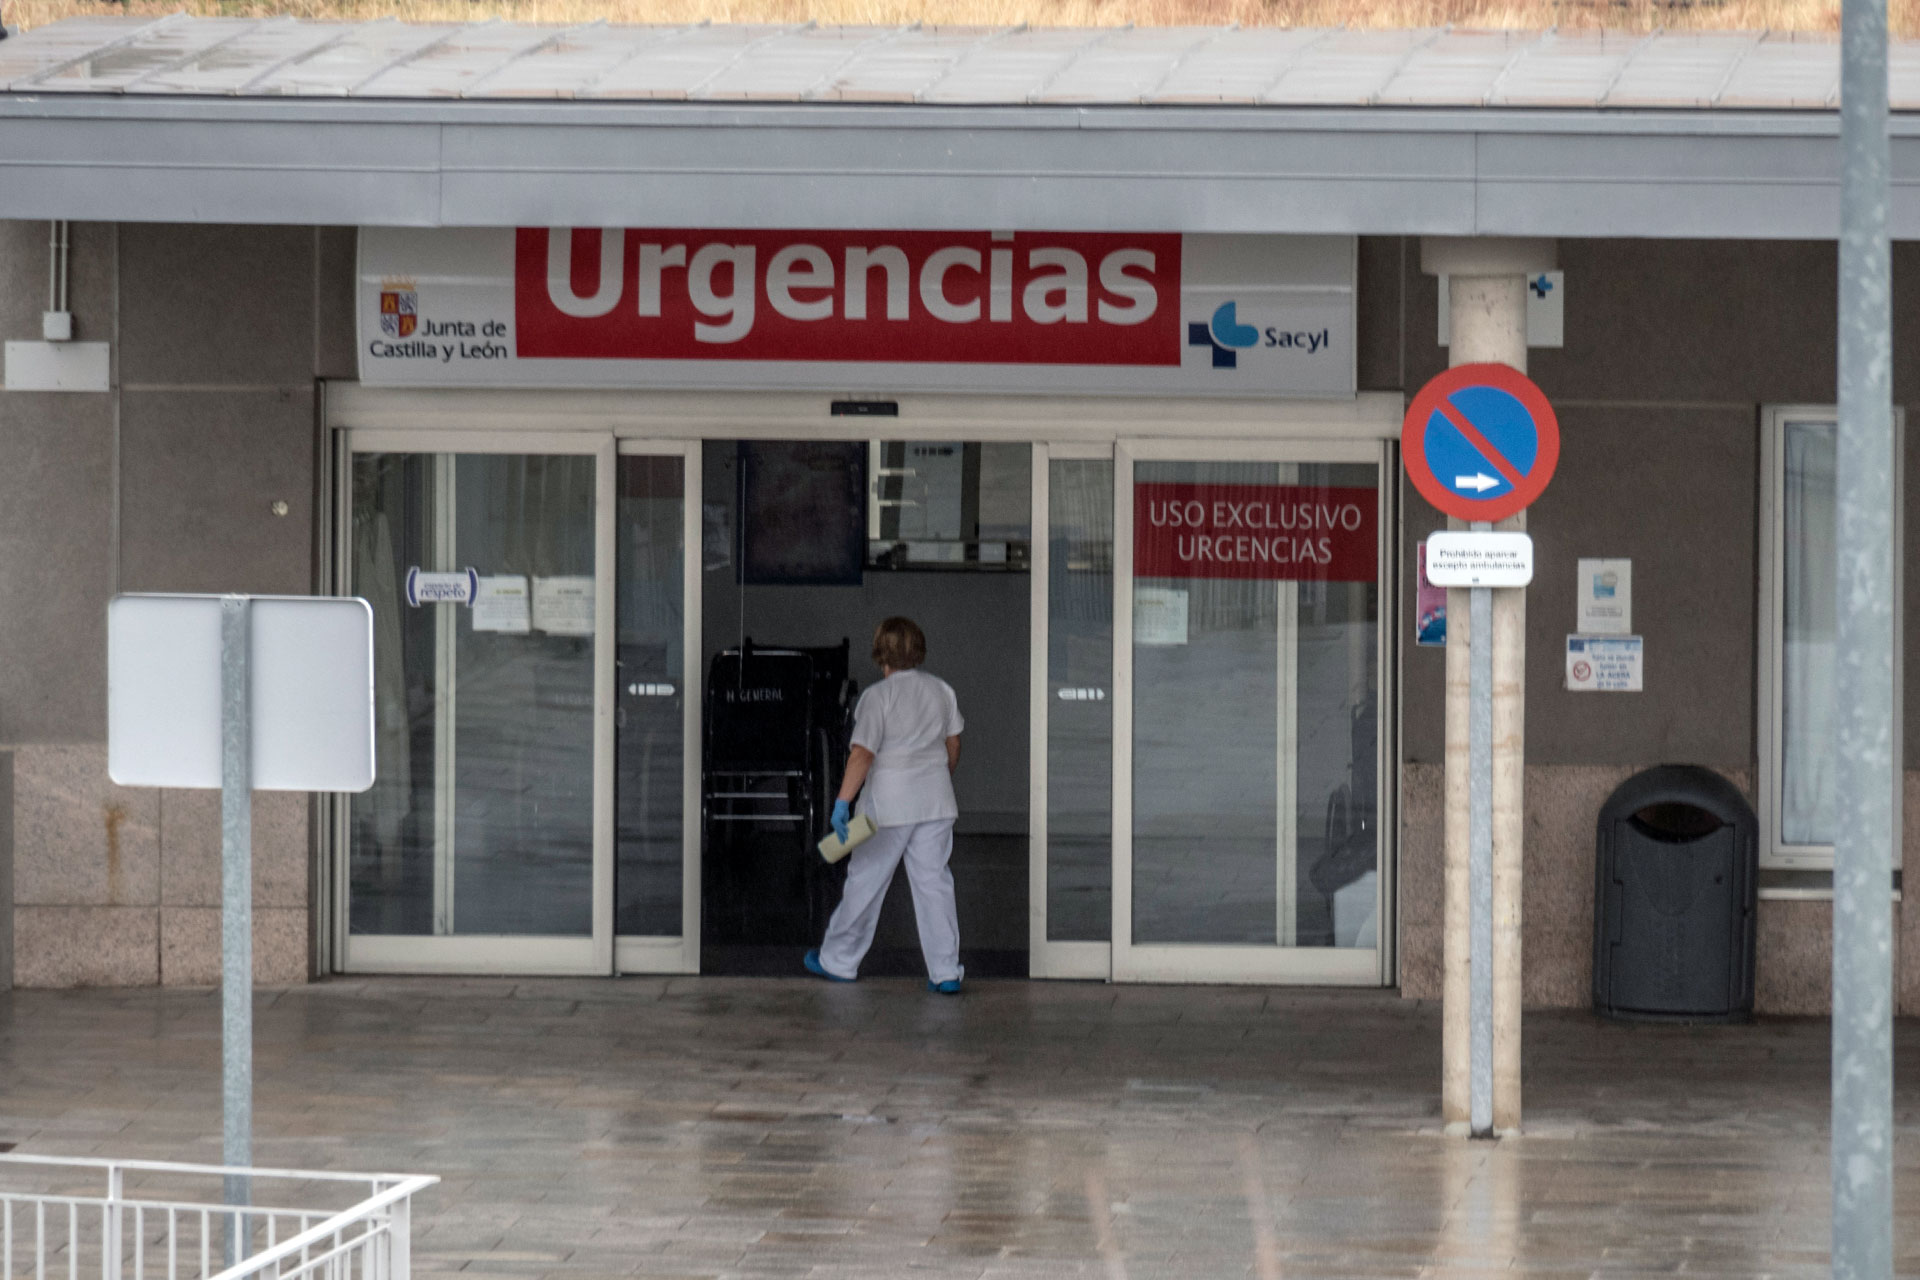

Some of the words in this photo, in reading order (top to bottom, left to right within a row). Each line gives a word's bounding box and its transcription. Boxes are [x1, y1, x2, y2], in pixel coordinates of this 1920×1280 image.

[547, 228, 1158, 343] Urgencias
[421, 320, 476, 337] Junta
[482, 319, 507, 337] de
[1265, 327, 1328, 353] Sacyl
[370, 339, 438, 358] Castilla
[442, 344, 455, 363] y
[461, 339, 508, 359] León
[1149, 500, 1205, 528] USO
[1213, 502, 1362, 531] EXCLUSIVO
[1178, 534, 1333, 564] URGENCIAS
[1439, 548, 1482, 559] Prohibido
[1484, 550, 1518, 560] aparcar
[1432, 561, 1468, 571] excepto
[1469, 560, 1526, 570] ambulancias
[420, 587, 466, 600] respeto
